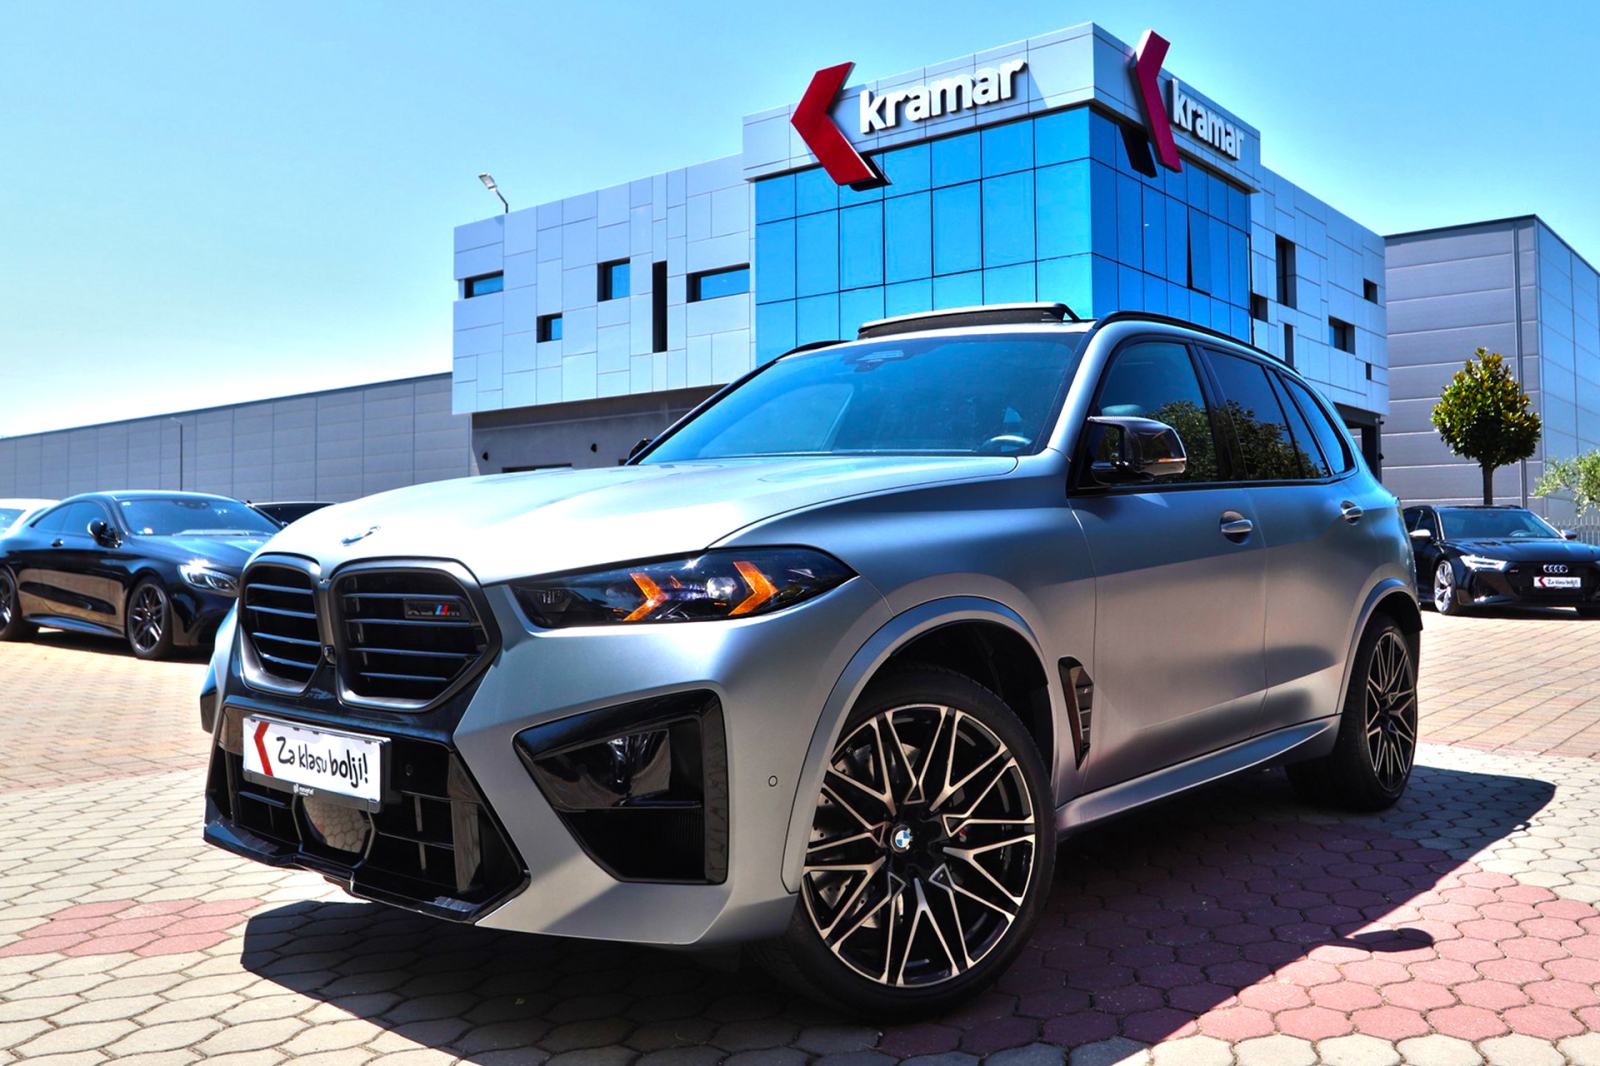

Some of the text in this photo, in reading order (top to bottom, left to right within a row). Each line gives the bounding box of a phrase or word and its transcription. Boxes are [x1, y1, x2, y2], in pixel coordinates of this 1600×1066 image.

[860, 60, 1028, 134] kramar
[1171, 78, 1244, 161] kramar
[276, 736, 369, 788] Za klasu bolji!
